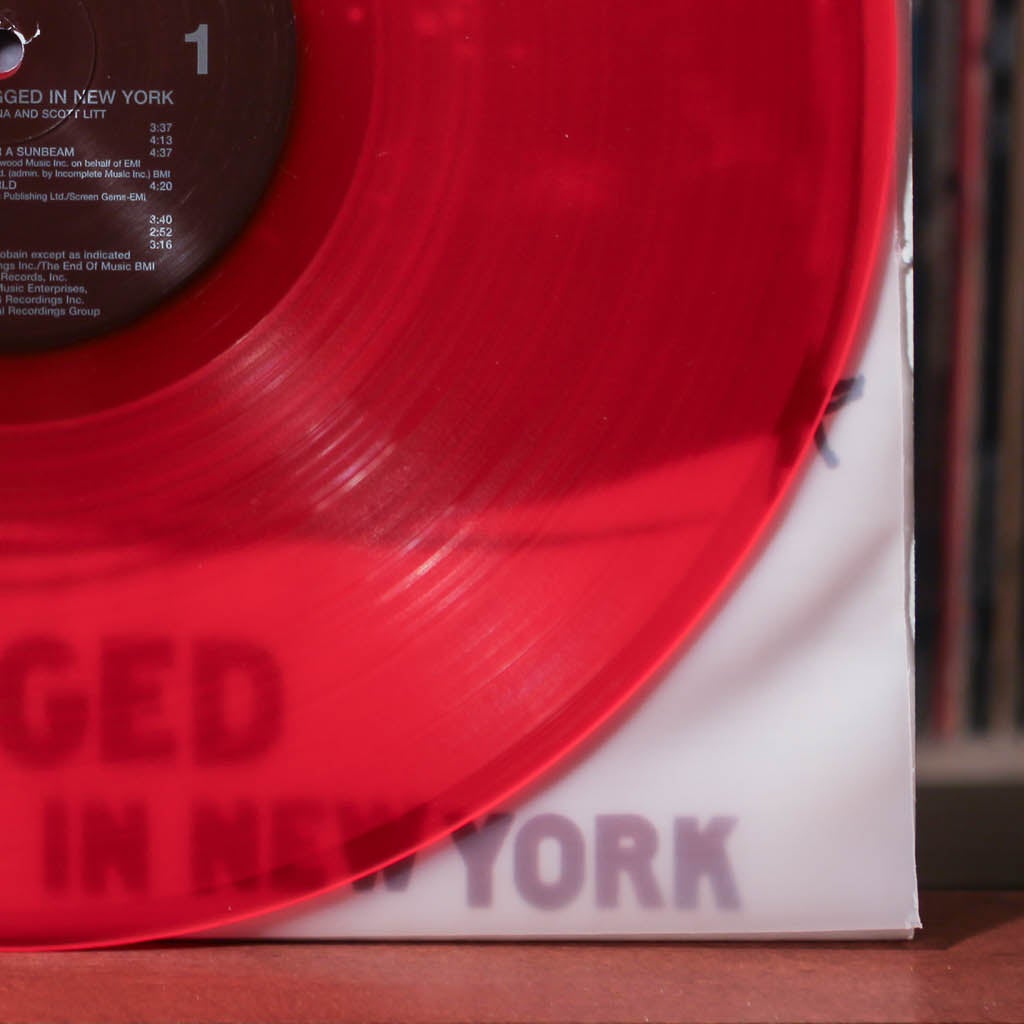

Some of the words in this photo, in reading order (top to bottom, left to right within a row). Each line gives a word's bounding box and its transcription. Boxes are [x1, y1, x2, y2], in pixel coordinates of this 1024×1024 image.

[184, 24, 209, 75] 1
[49, 88, 67, 104] IN
[74, 88, 116, 105] NEW
[121, 89, 174, 105] YORK
[14, 108, 39, 119] AND
[83, 109, 107, 119] LITT
[149, 123, 172, 132] 3:37
[149, 135, 172, 145] 4:13
[5, 147, 13, 157] A
[16, 147, 75, 157] SUNBEAM
[149, 148, 172, 158] 4:37
[149, 181, 173, 191] 4:20
[149, 214, 173, 224] 3:40
[149, 227, 173, 237] 2:52
[149, 240, 173, 249] 3:16
[31, 250, 65, 261] except
[83, 250, 131, 260] indicated
[18, 262, 59, 271] Inc./The
[63, 262, 83, 271] End
[86, 262, 98, 271] Of
[101, 262, 131, 271] Music
[134, 262, 155, 271] BMI
[1, 272, 46, 282] Records,
[49, 273, 68, 281] Inc.
[27, 283, 88, 294] Enterprises,
[5, 295, 63, 306] Recordings
[66, 295, 84, 304] Inc.
[8, 307, 66, 318] Recordings
[68, 307, 101, 318] Group
[42, 797, 149, 894] IN
[190, 798, 428, 894] NEW
[450, 812, 742, 911] YORK
